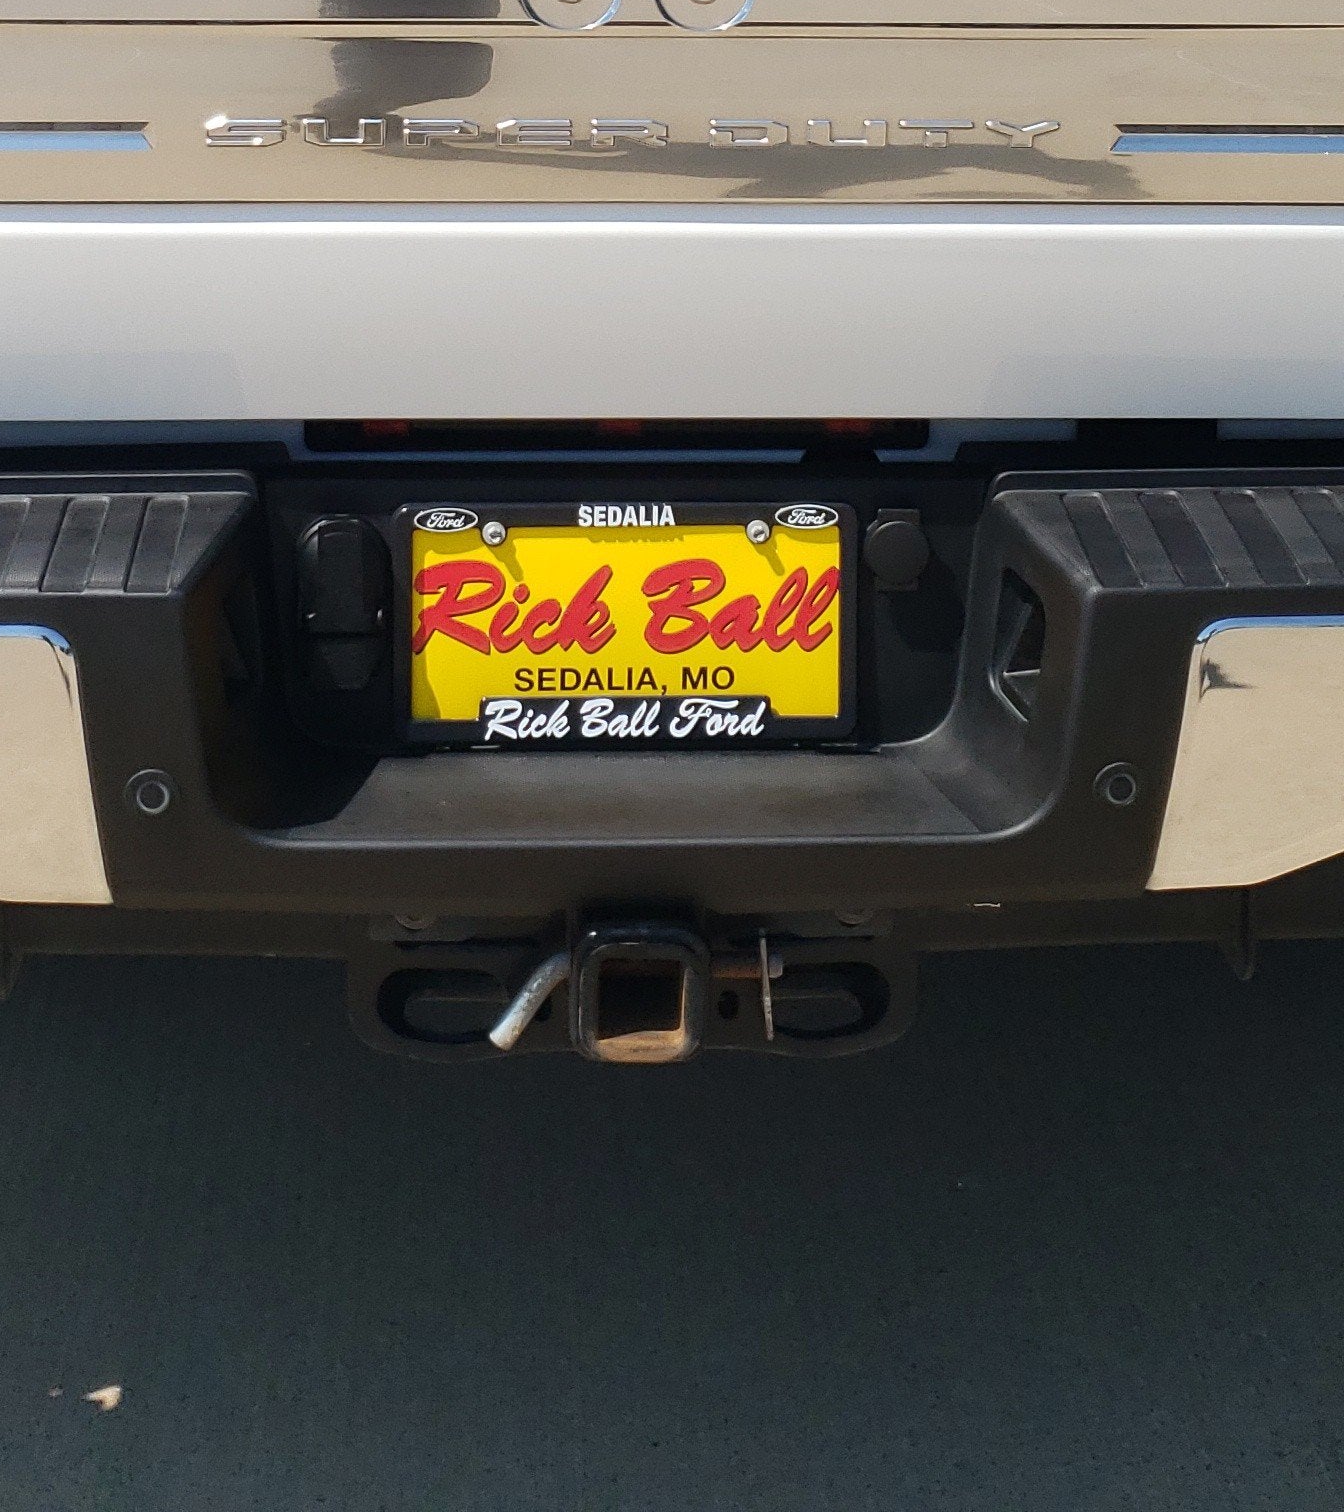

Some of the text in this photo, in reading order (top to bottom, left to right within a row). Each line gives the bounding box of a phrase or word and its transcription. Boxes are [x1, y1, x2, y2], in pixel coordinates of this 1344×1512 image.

[205, 115, 1060, 149] SUPER DUTY
[425, 511, 466, 529] Ford
[577, 504, 676, 528] SEDALIA
[786, 508, 826, 525] Ford
[412, 558, 840, 655] Rick Ball
[514, 666, 736, 695] SEDALIA, MO
[483, 698, 767, 741] Rick Ball Ford
